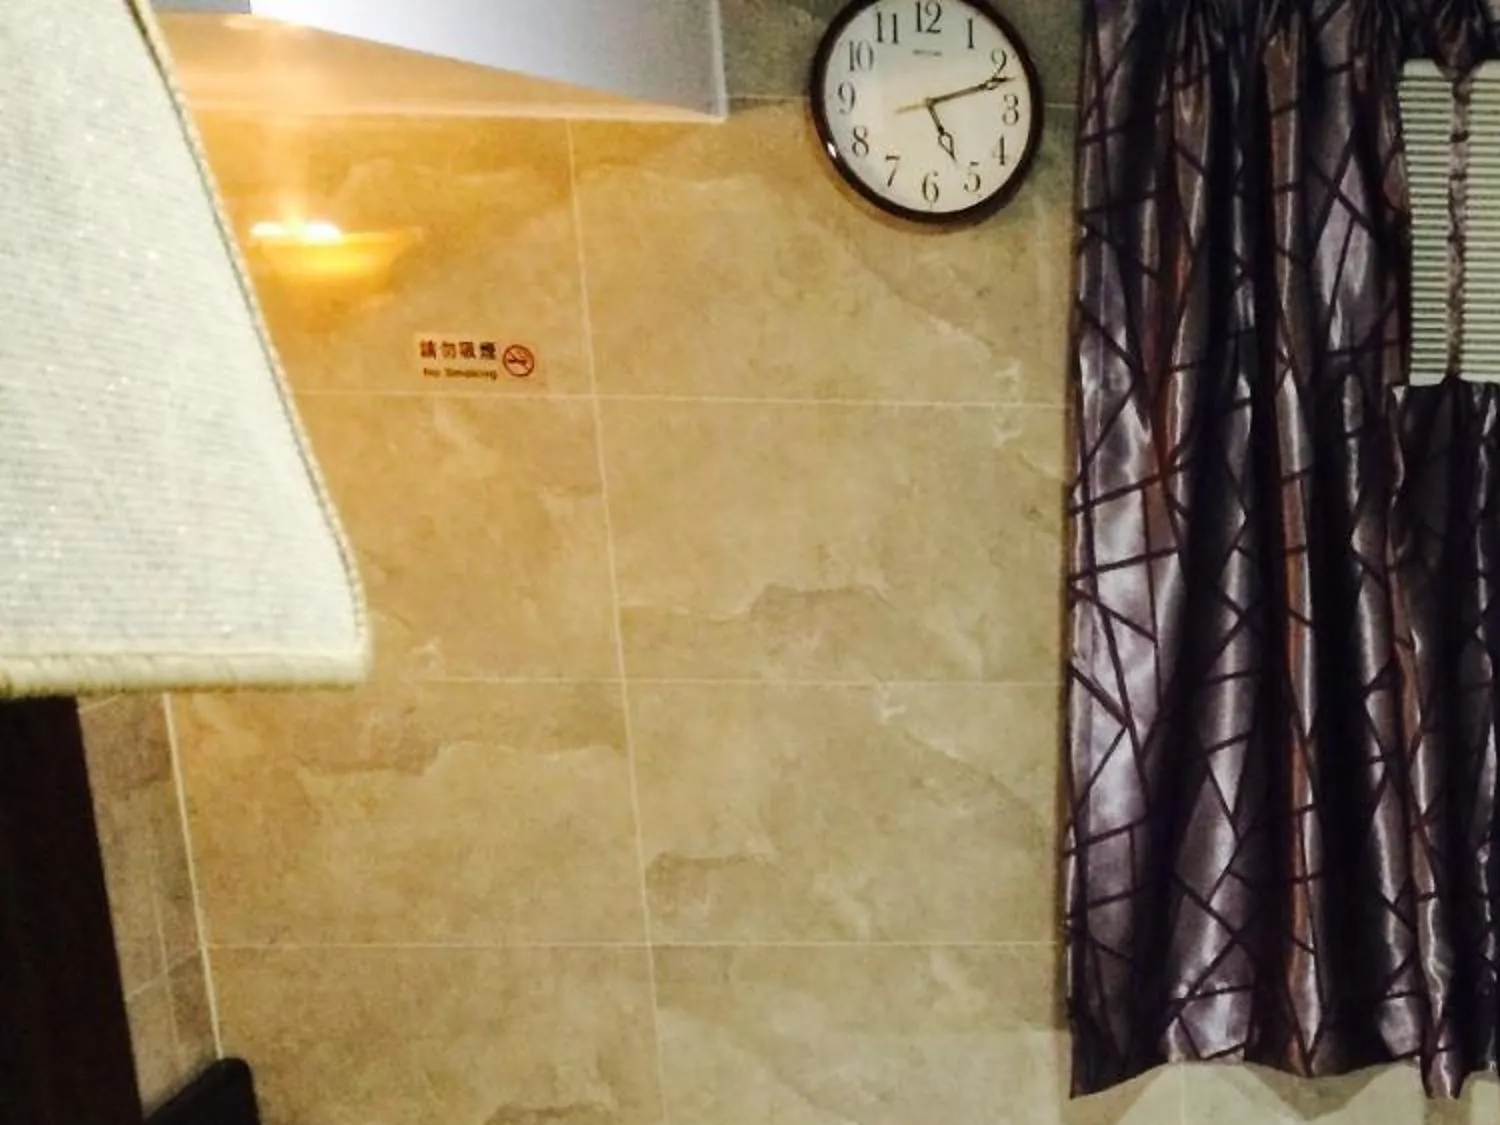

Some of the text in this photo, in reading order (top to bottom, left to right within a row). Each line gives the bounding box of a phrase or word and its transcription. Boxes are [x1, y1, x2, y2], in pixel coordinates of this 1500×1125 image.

[875, 12, 899, 44] 11
[915, 0, 941, 34] 12
[849, 40, 874, 72] 10
[991, 48, 1008, 81] 2
[837, 81, 856, 115] 9
[1002, 94, 1019, 126] 3
[851, 124, 869, 157] 8
[992, 135, 1008, 166] 4
[885, 155, 900, 188] 7
[921, 171, 940, 205] 6
[963, 161, 981, 194] 5
